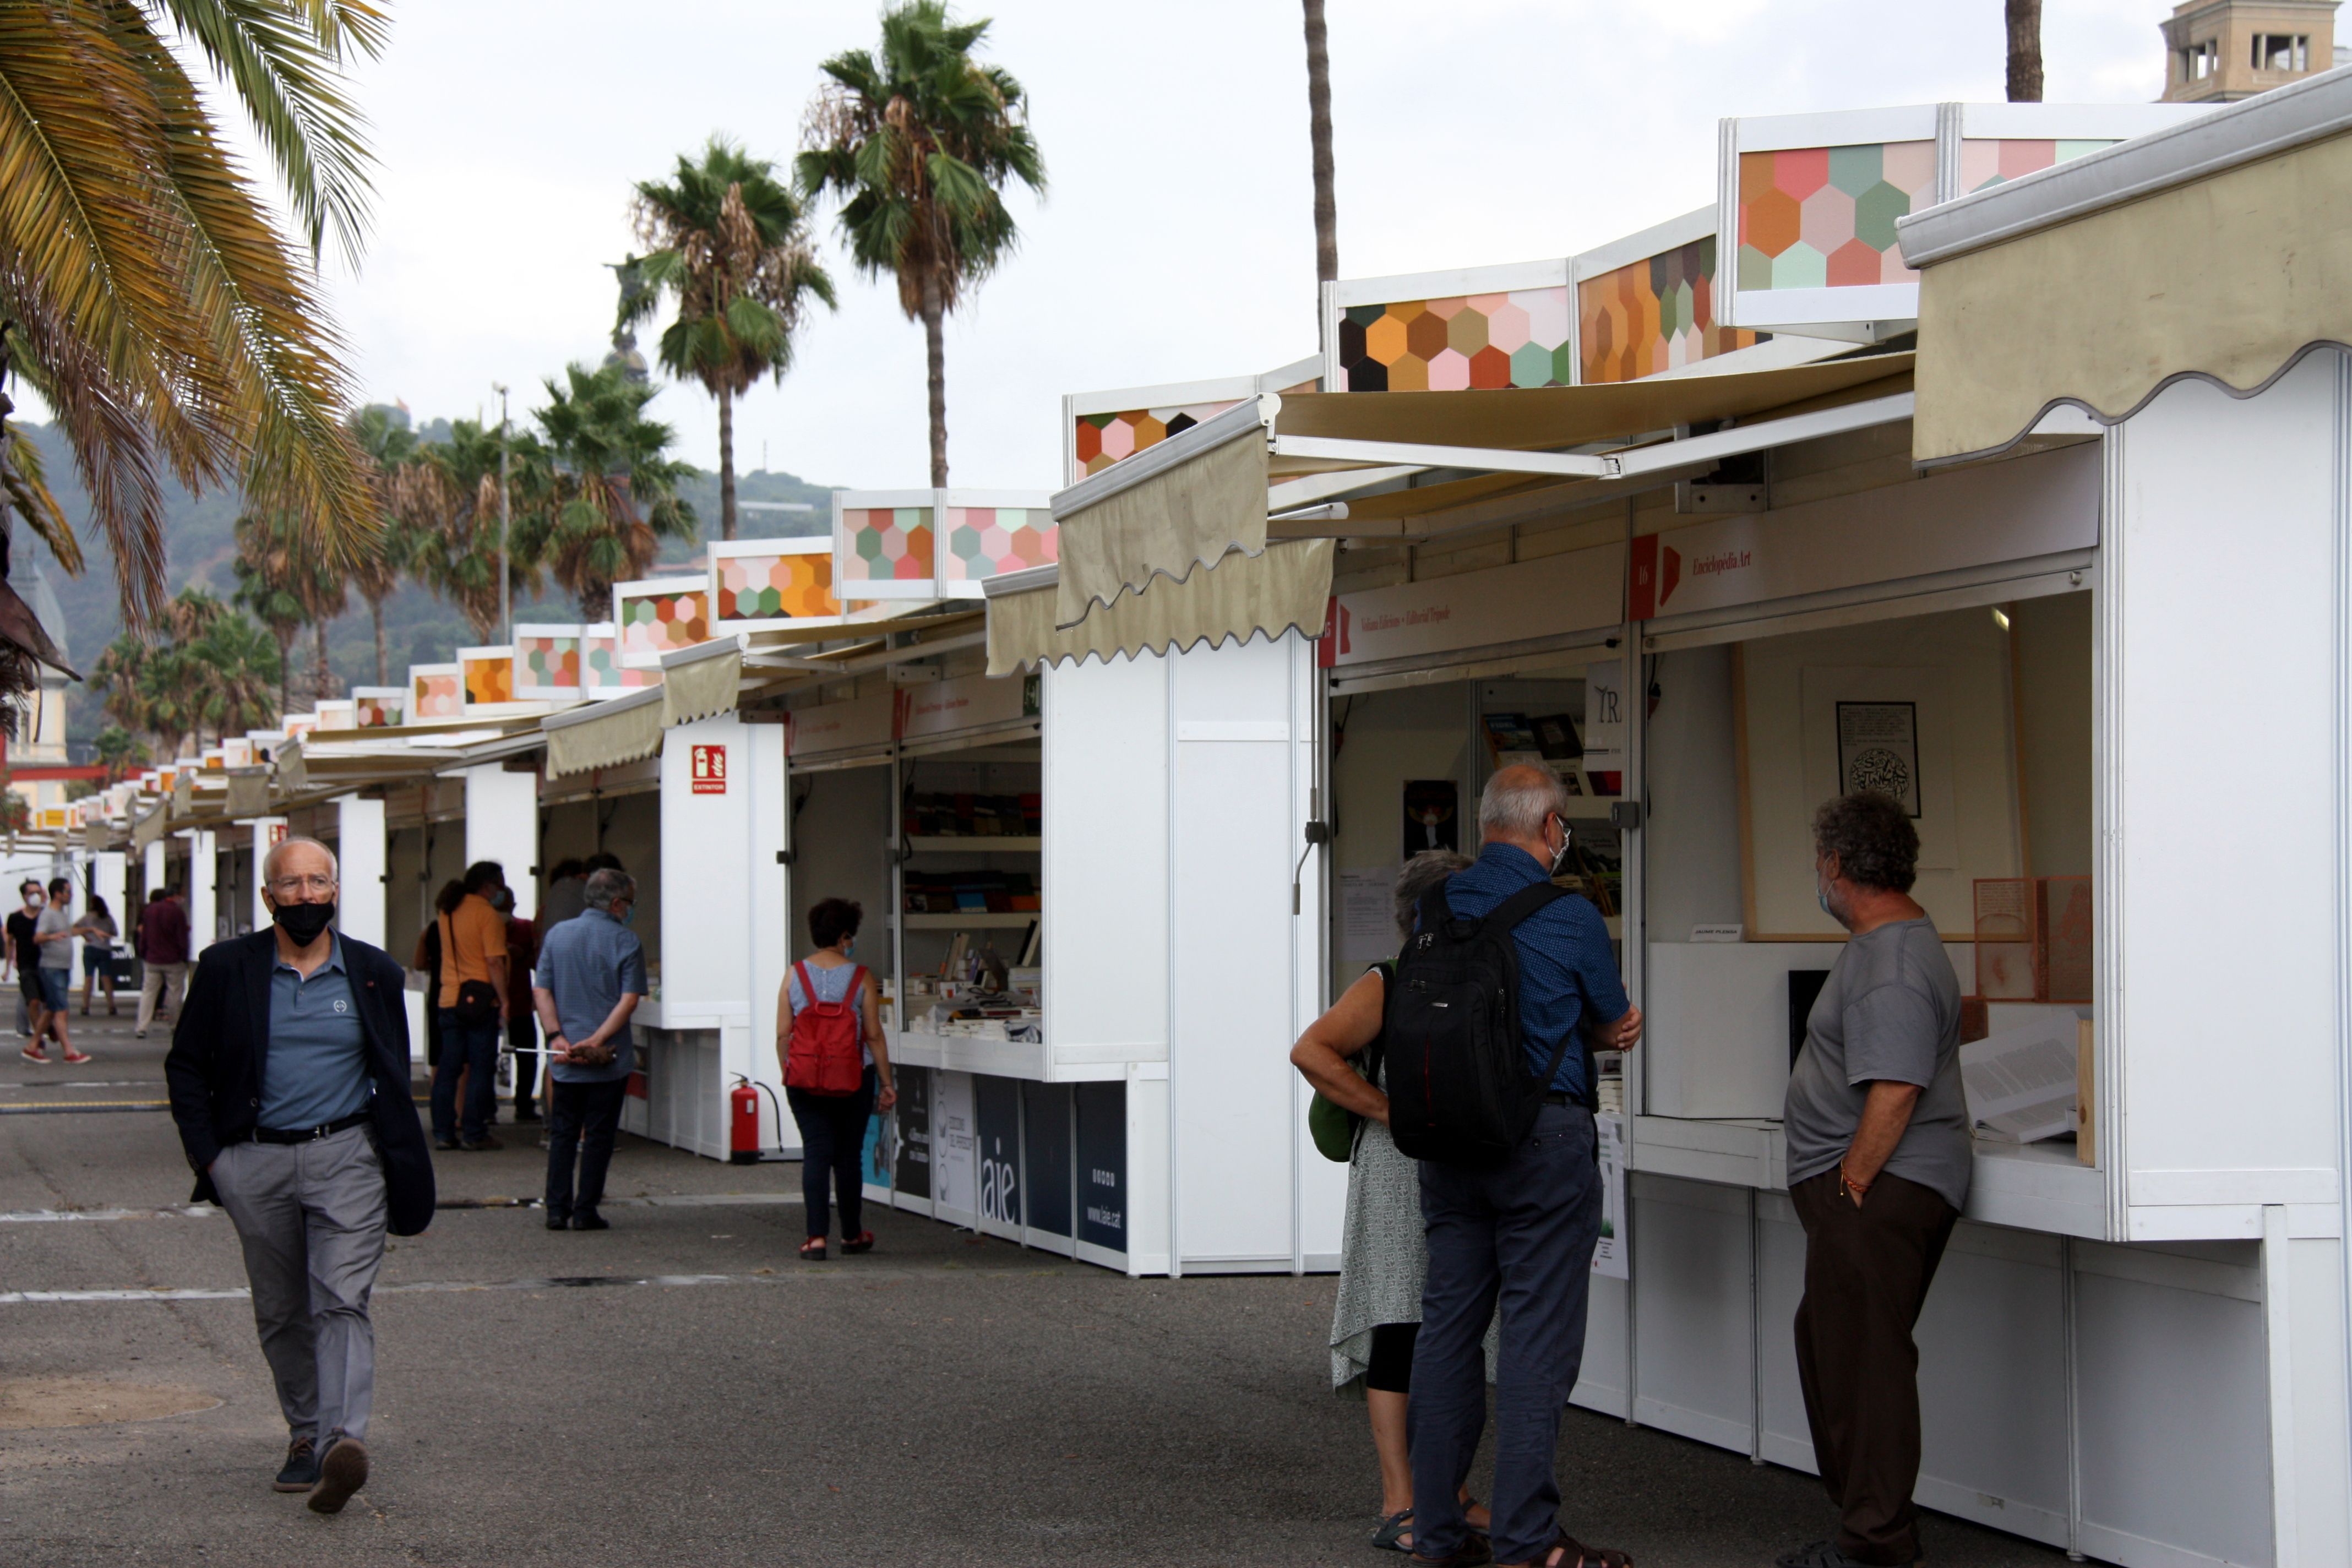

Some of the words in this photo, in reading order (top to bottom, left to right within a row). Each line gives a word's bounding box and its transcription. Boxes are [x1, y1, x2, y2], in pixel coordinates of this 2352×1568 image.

[1738, 550, 1751, 568] Art
[1639, 564, 1648, 585] 16
[1406, 608, 1429, 626] Editorial
[1087, 1204, 1121, 1229] www.laie.cat
